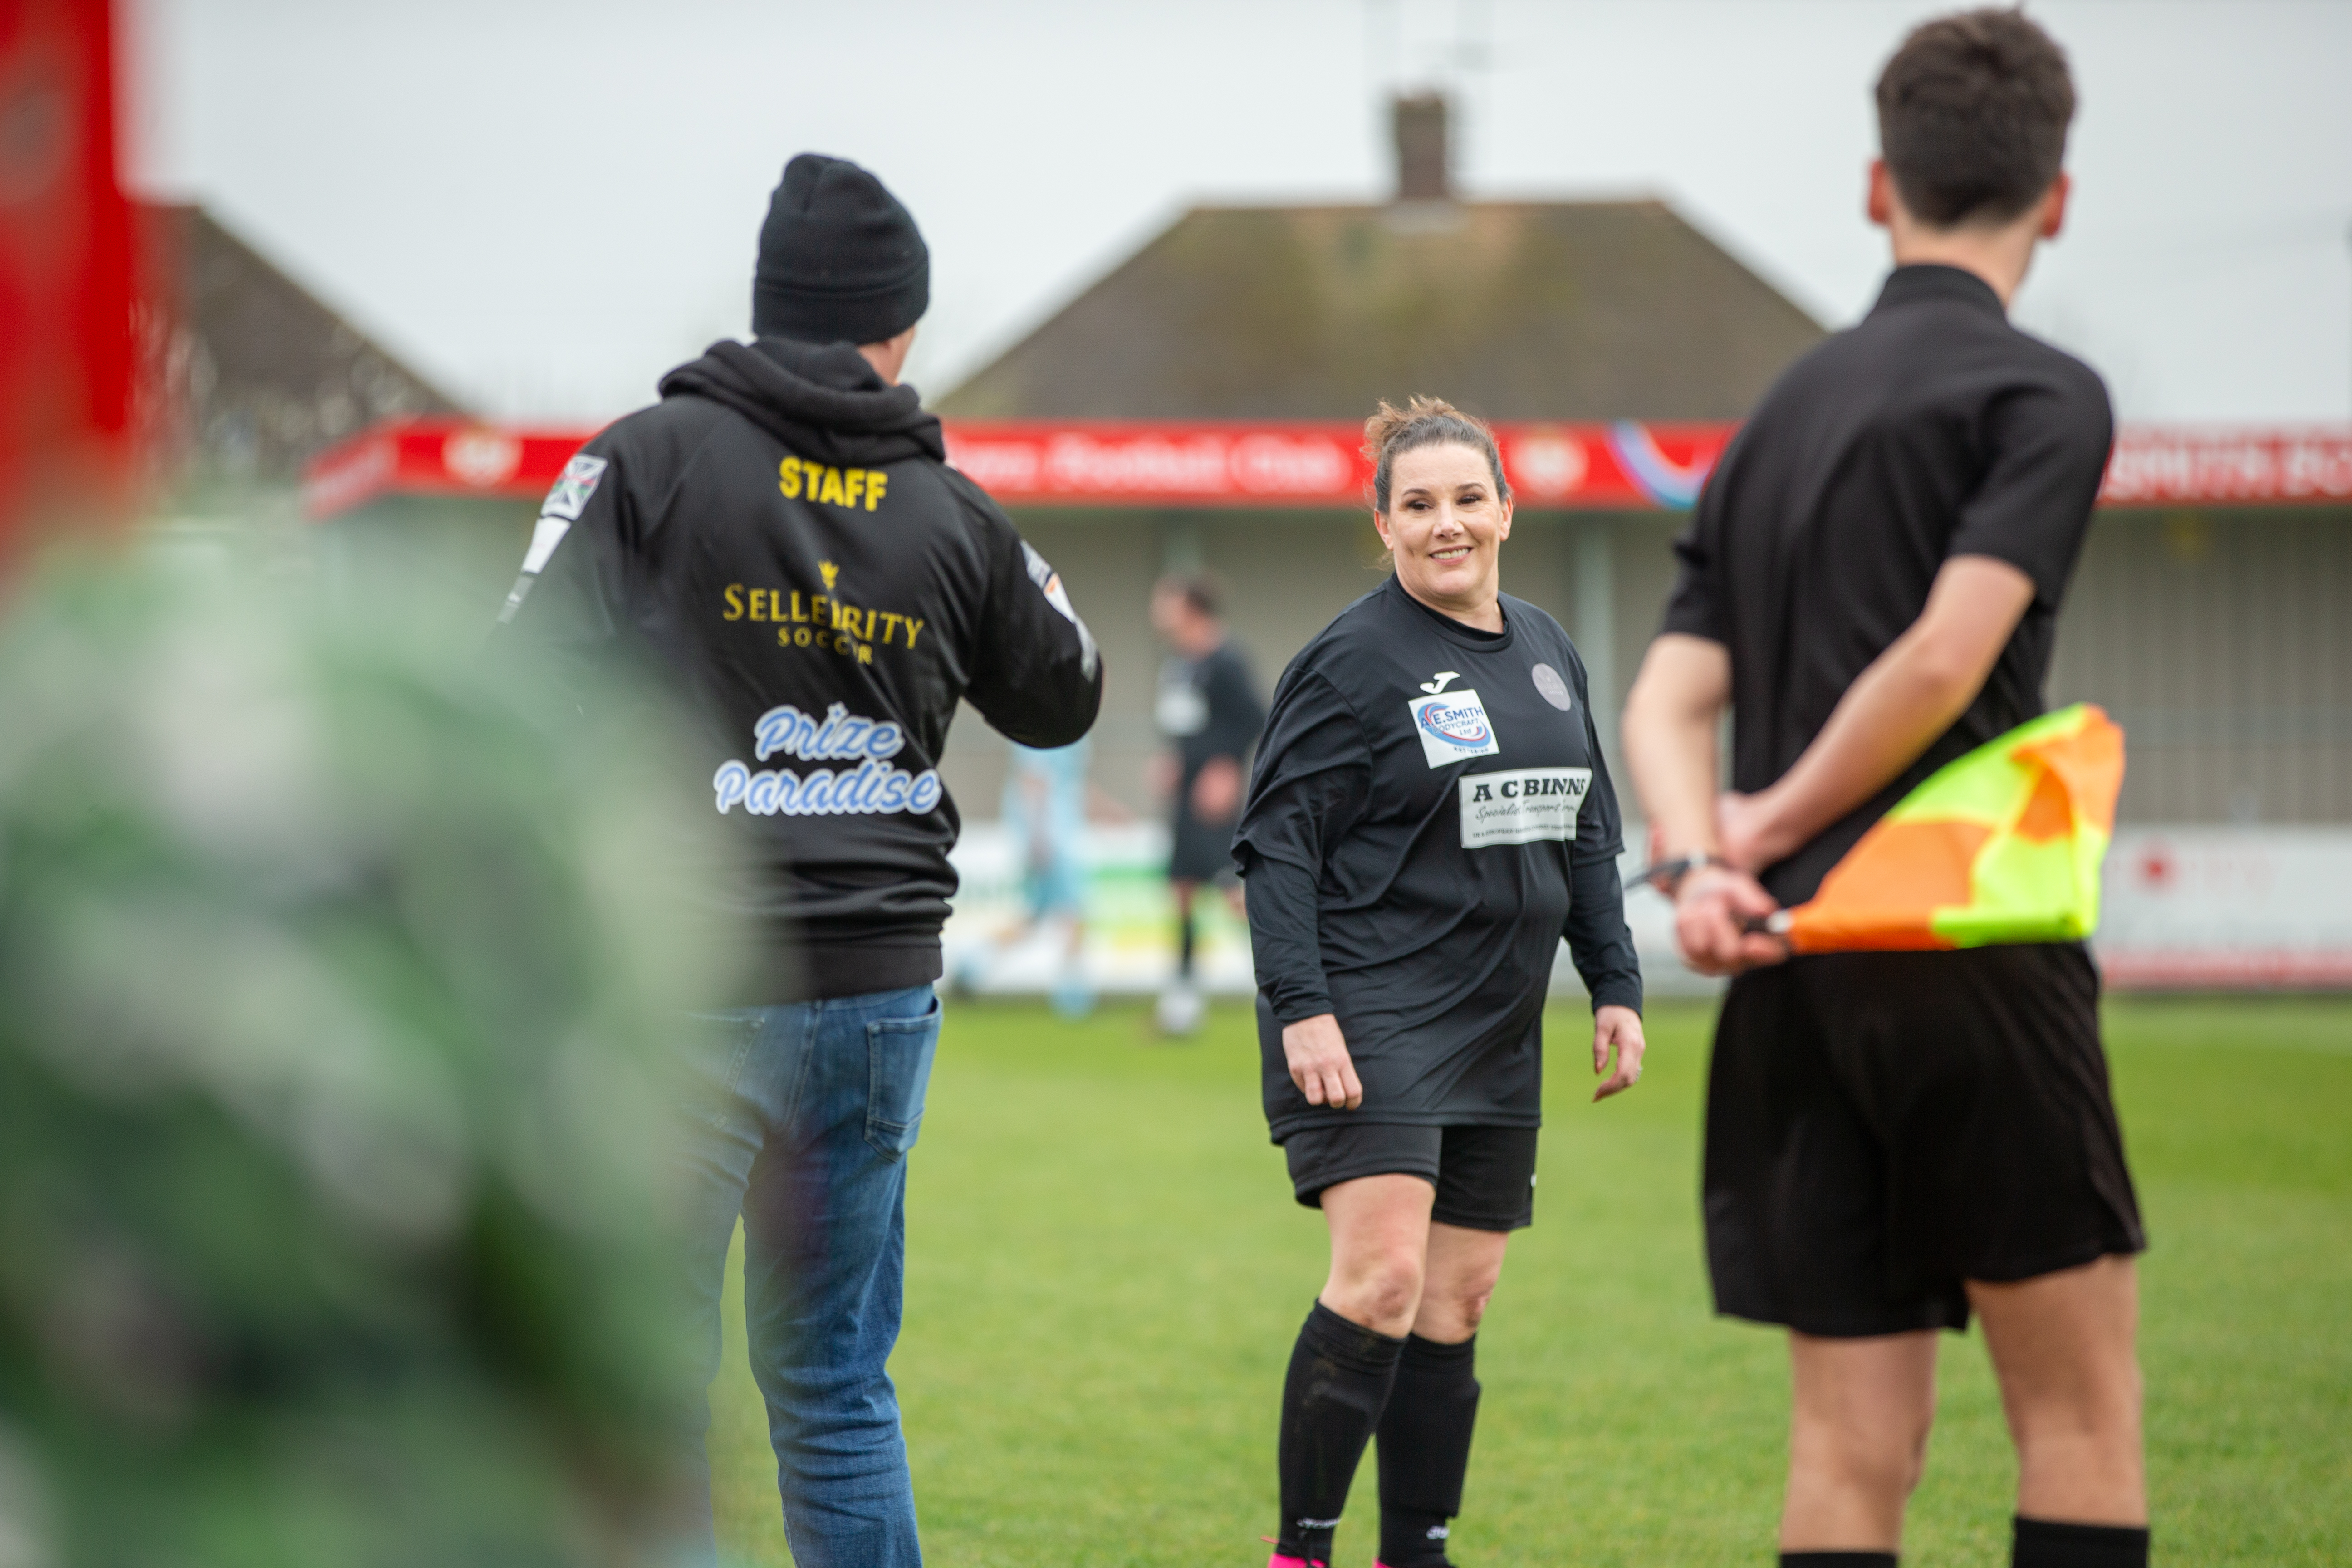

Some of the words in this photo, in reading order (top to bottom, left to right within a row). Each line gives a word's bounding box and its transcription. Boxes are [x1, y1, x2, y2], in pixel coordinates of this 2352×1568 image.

[779, 456, 888, 511] STAFF
[755, 702, 904, 760] Prize
[1433, 717, 1479, 734] BODYCRAFT
[713, 759, 942, 815] Paradise
[1473, 784, 1493, 803] A
[1500, 780, 1518, 798] C
[1475, 802, 1520, 824] Specialis
